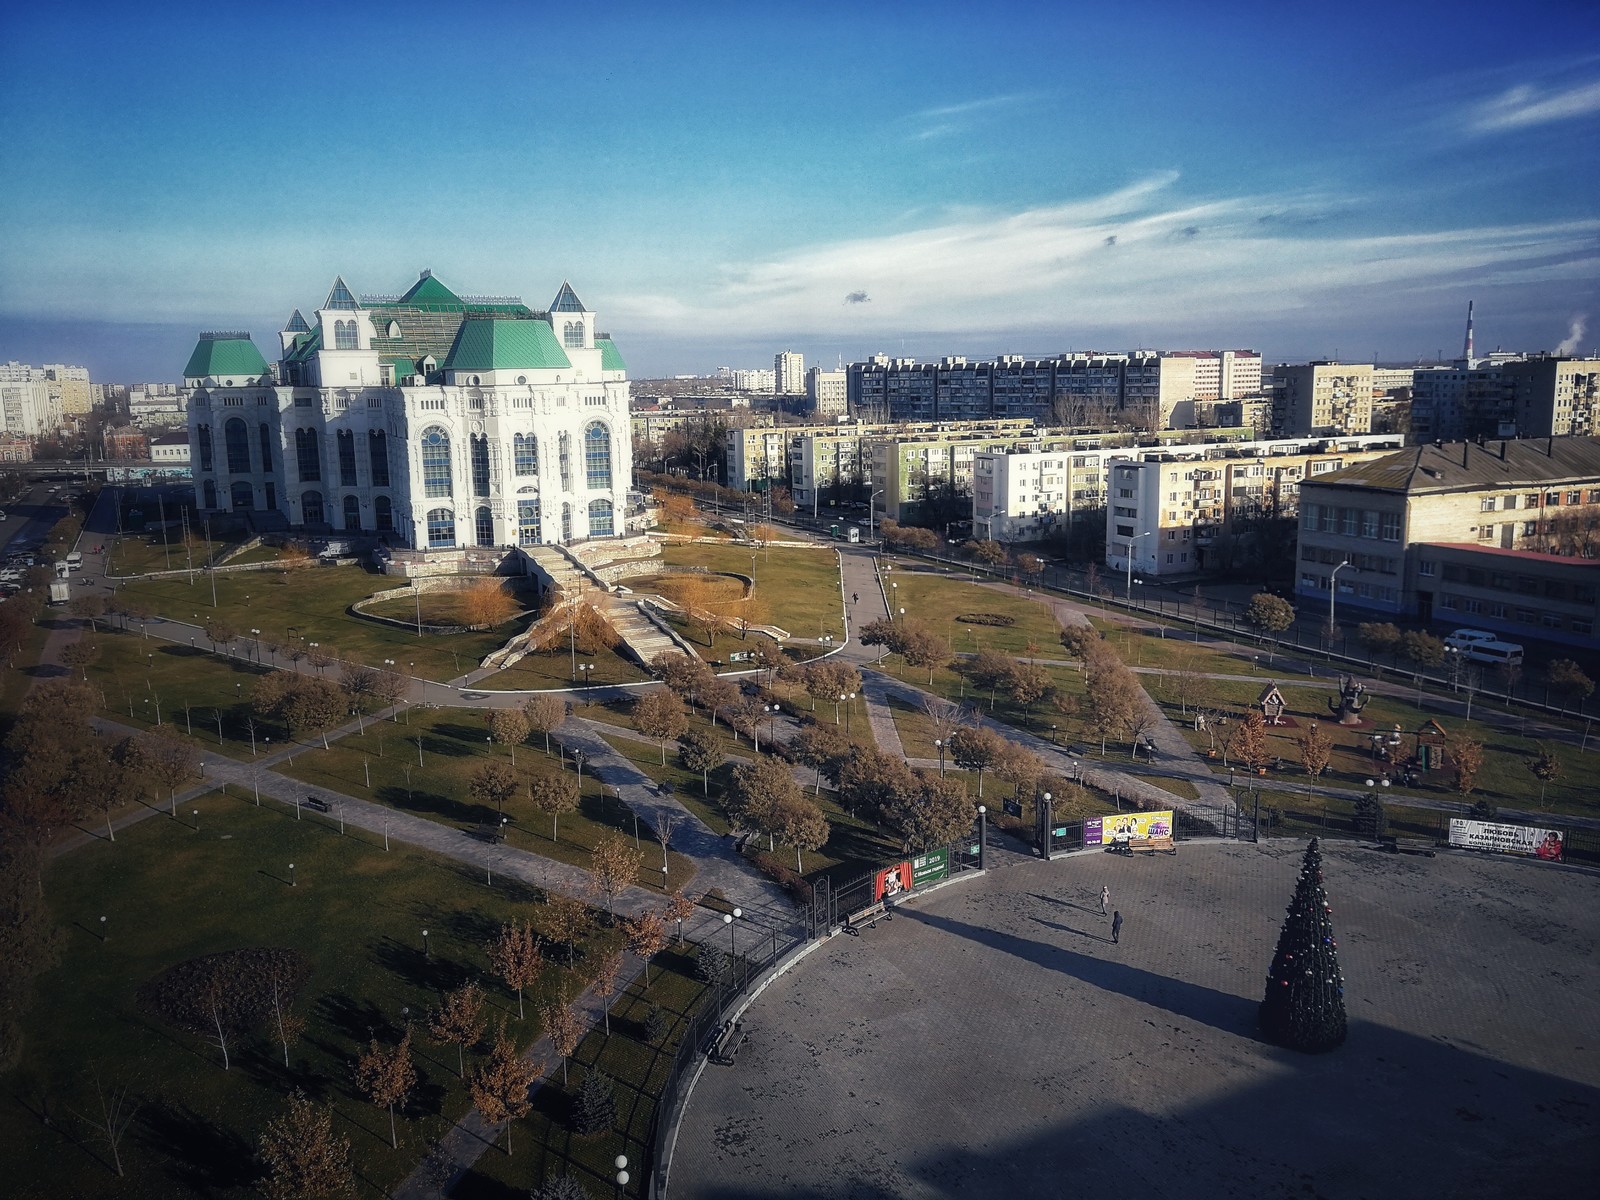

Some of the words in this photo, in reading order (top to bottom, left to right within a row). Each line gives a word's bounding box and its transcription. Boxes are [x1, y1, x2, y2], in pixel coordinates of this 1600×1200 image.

[1483, 828, 1519, 838] ЛЮБОВЬ
[1469, 833, 1533, 846] КАЗАРНОВСКАЯ
[929, 855, 941, 864] 2019
